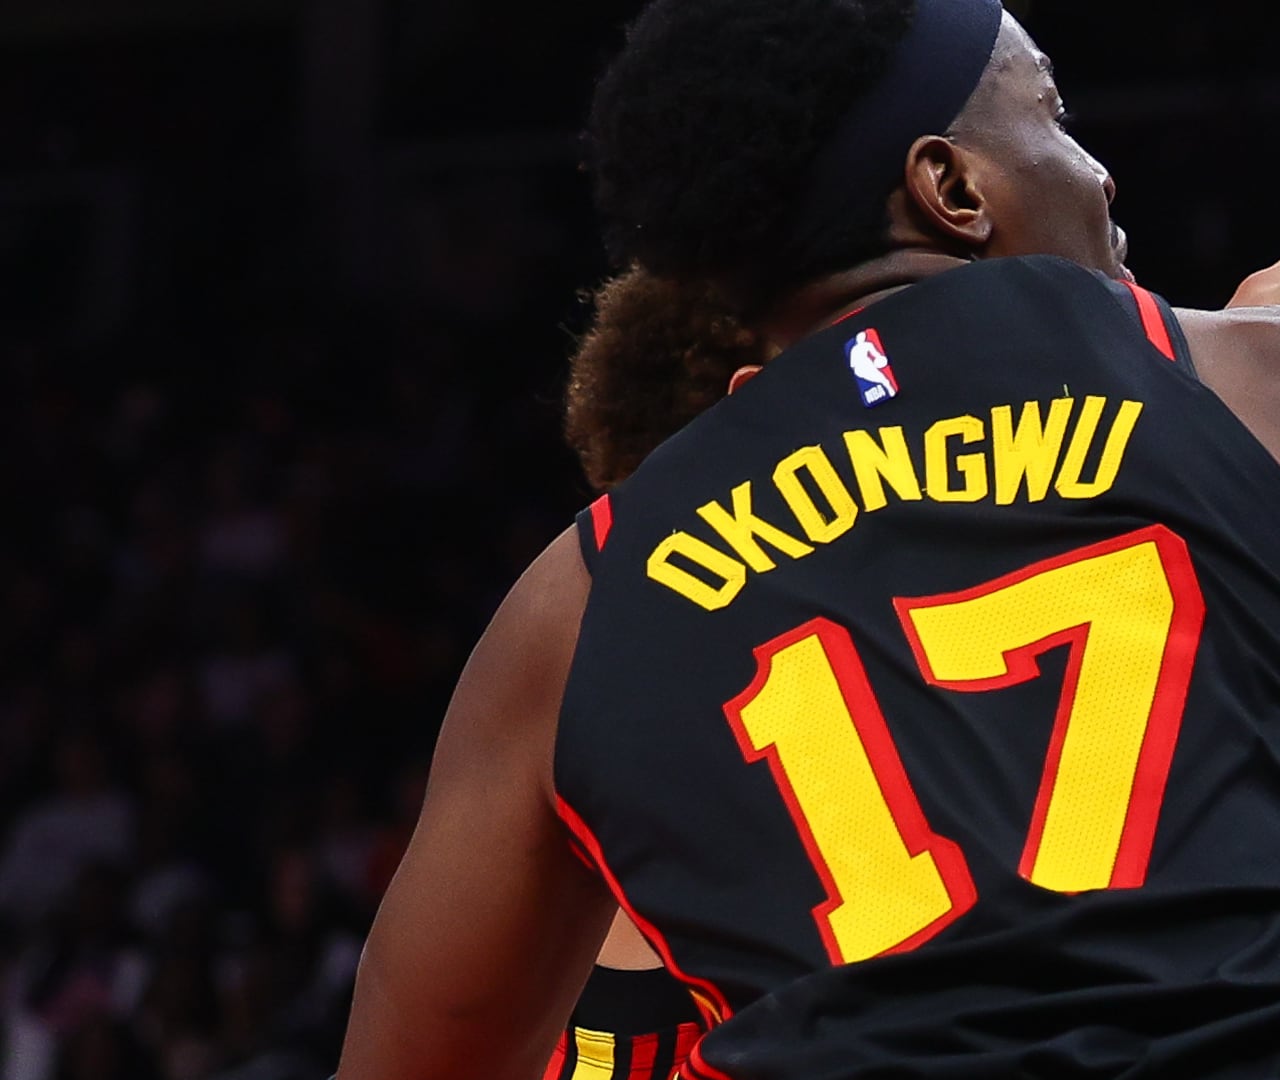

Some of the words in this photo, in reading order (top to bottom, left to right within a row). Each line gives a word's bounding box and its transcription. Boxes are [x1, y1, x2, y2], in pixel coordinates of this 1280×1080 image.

[864, 384, 887, 404] NBA
[646, 395, 1143, 612] OKONGWU
[722, 522, 1206, 967] 17
